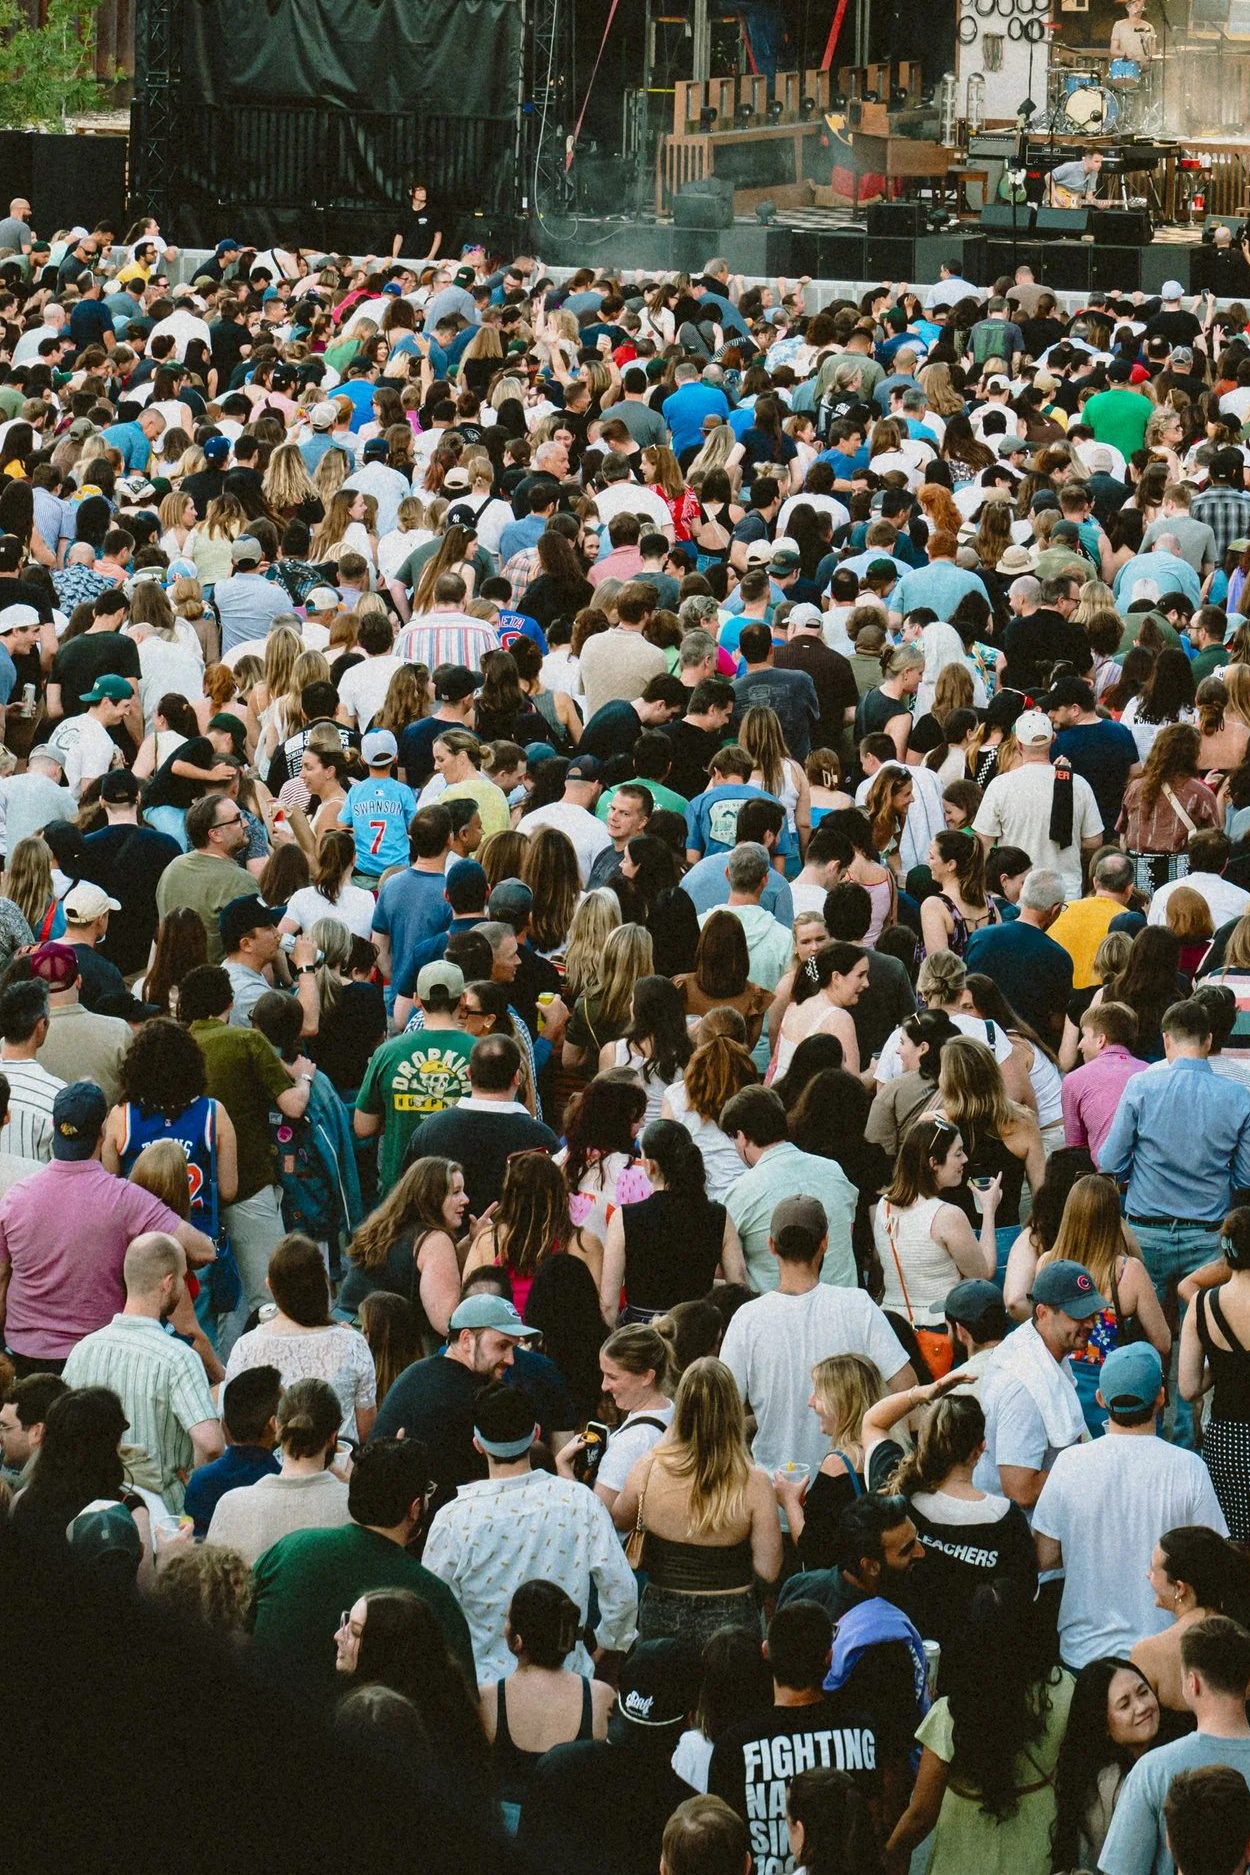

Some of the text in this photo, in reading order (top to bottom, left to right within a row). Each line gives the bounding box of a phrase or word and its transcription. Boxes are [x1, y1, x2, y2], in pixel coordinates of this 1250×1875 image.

[501, 615, 525, 630] ETA
[1055, 770, 1070, 780] ER
[353, 799, 403, 817] SWANSON
[369, 820, 387, 856] 7
[1077, 1274, 1091, 1290] C
[916, 1531, 999, 1568] LEACHERS
[742, 1728, 877, 1784] FIGHTING
[745, 1780, 788, 1820] NA
[749, 1820, 792, 1857] SIN
